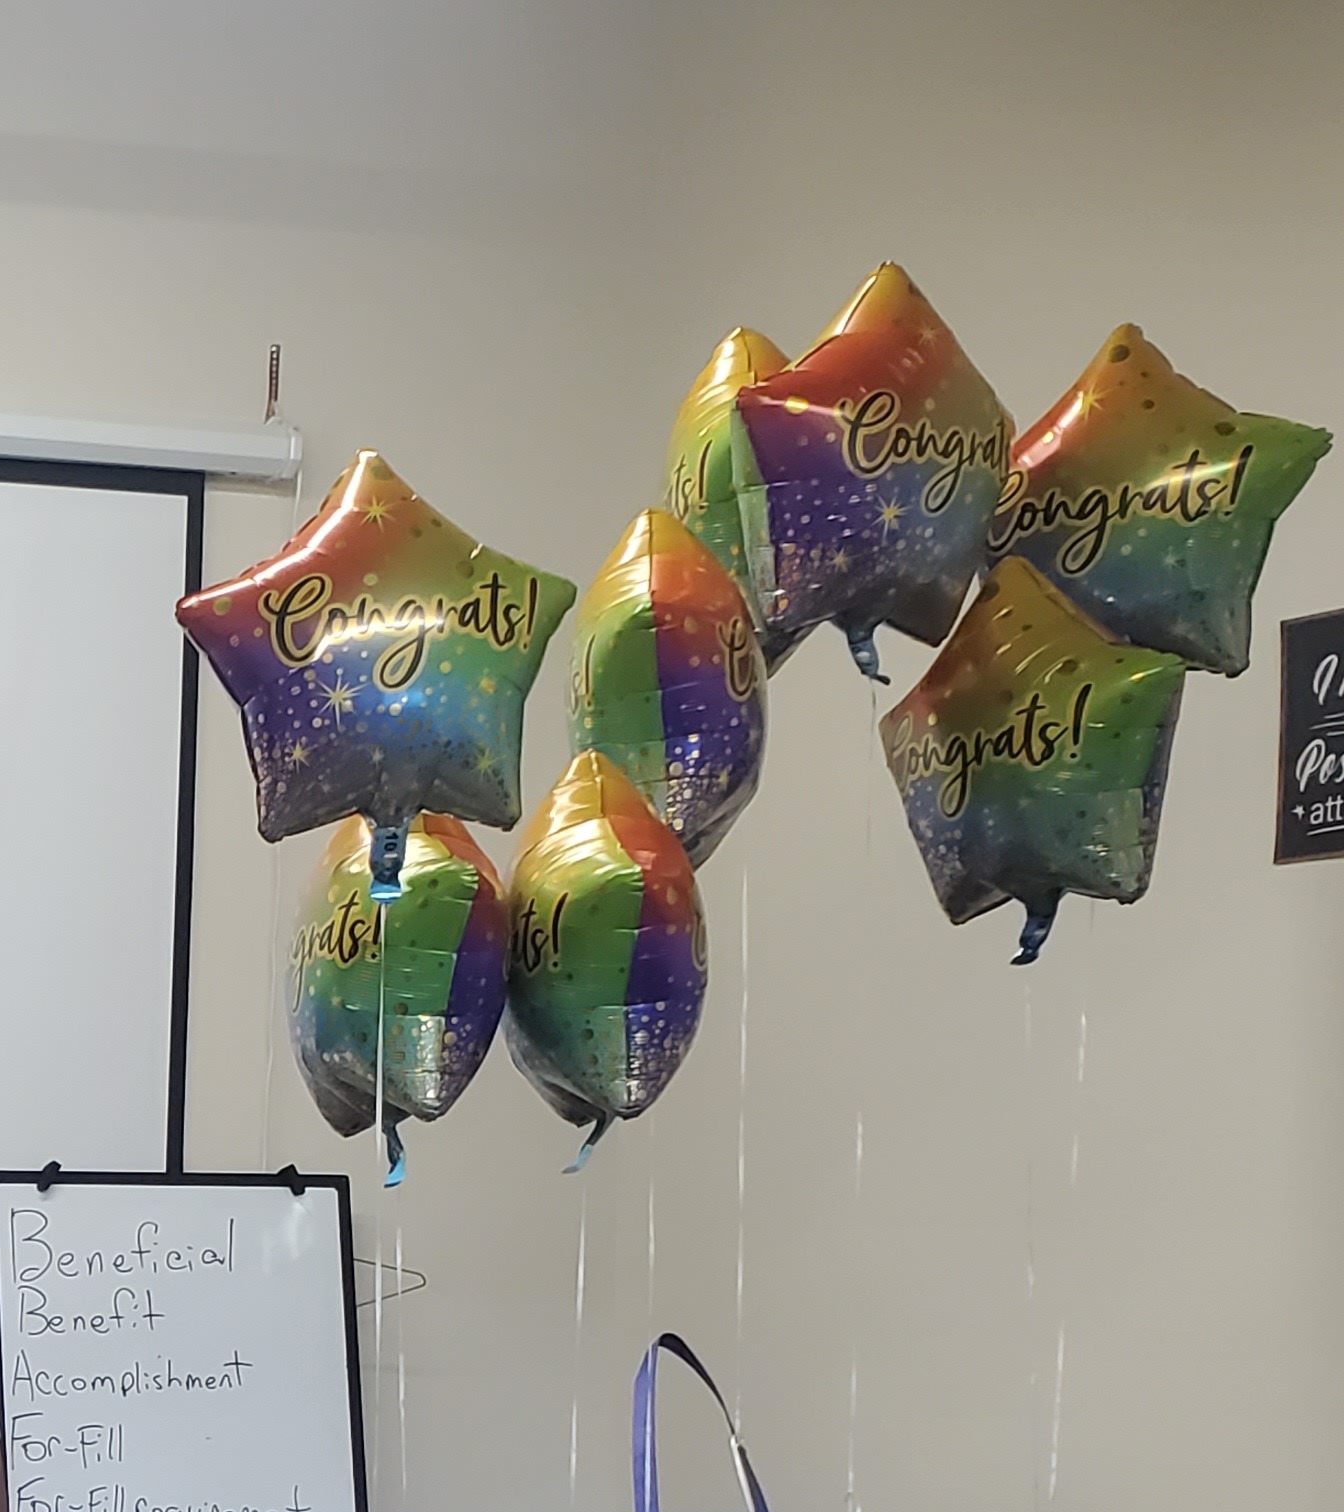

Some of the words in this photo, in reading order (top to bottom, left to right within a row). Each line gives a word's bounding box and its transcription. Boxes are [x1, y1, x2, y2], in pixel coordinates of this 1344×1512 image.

[263, 572, 538, 689] Congrats!
[10, 1208, 235, 1284] Beneficial
[17, 1286, 165, 1336] Benefit
[11, 1349, 254, 1401] Accomplishment
[11, 1412, 124, 1471] For-Fill
